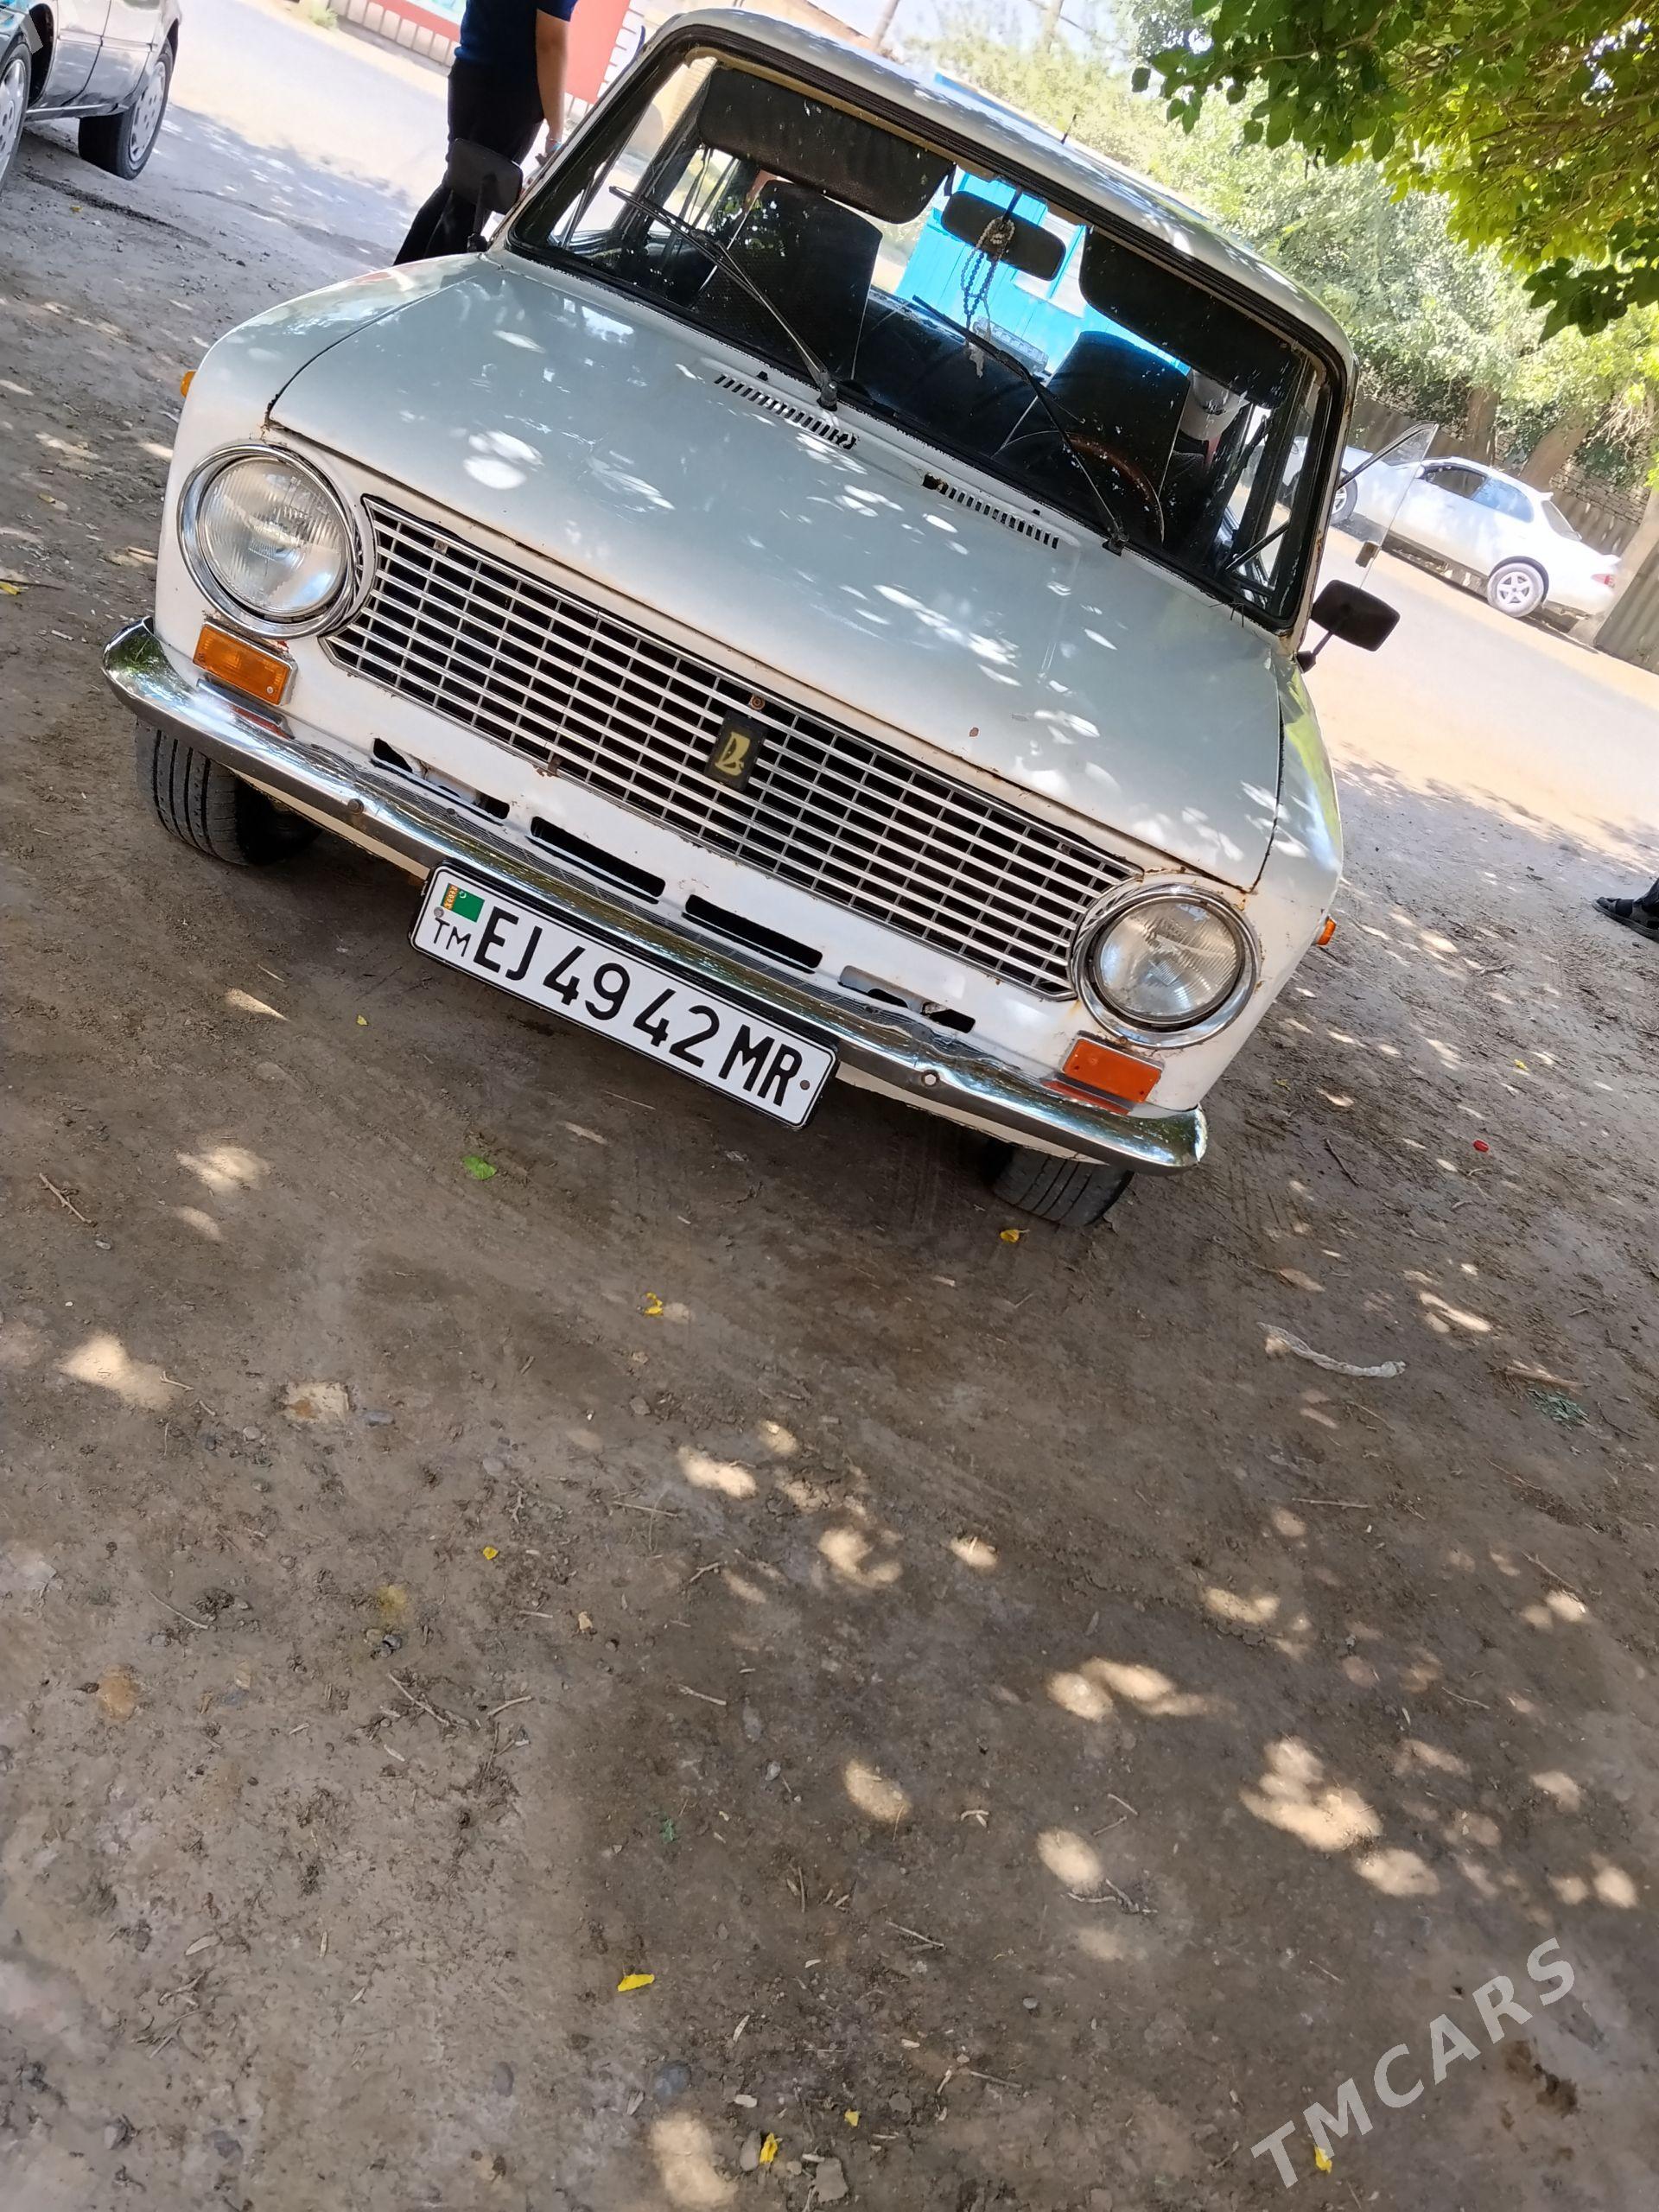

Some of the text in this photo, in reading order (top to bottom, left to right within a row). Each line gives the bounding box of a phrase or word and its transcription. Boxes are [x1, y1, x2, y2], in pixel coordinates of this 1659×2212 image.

[434, 918, 472, 957] TM
[474, 906, 543, 982] EJ
[718, 1024, 804, 1108] MR
